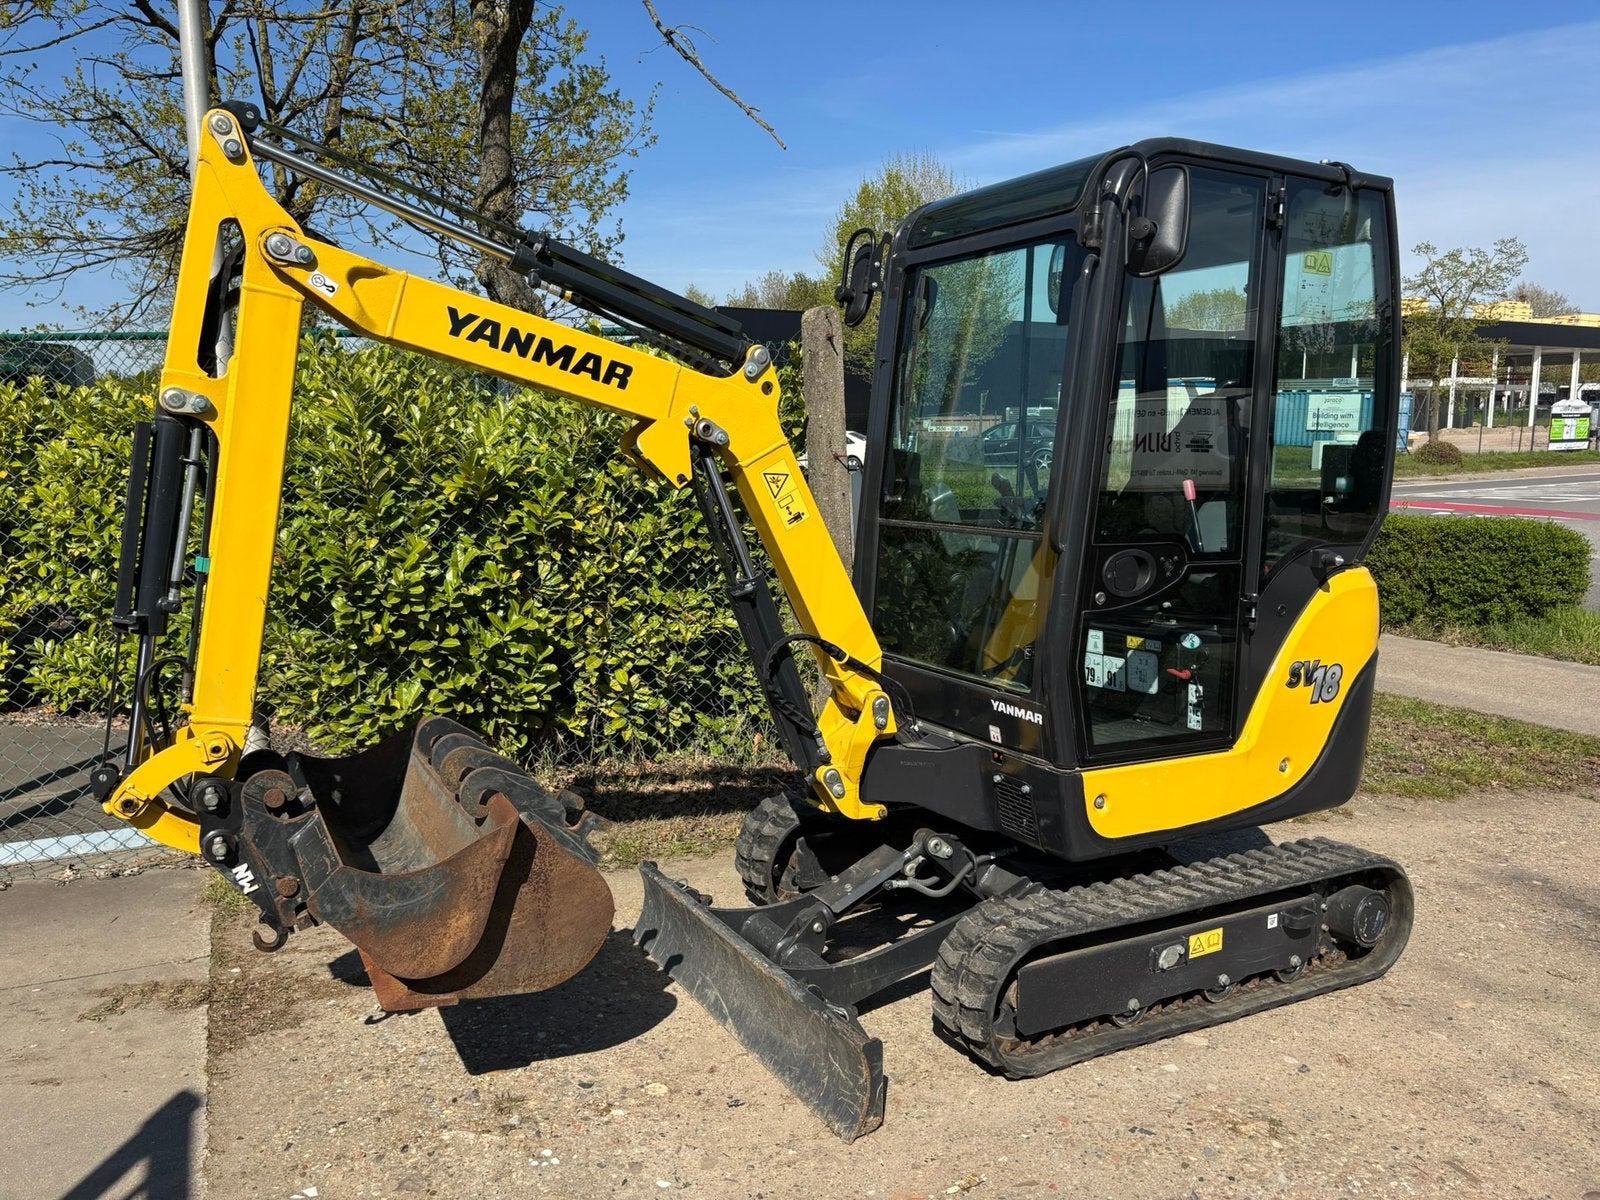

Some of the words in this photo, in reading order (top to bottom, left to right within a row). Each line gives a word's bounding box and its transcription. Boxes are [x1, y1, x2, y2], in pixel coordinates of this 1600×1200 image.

[447, 306, 634, 391] YANMAR
[1311, 421, 1350, 429] inelligence
[1086, 667, 1096, 683] 79
[1107, 670, 1117, 688] 91
[1285, 659, 1343, 704] SV18
[991, 699, 1043, 726] YANMAR
